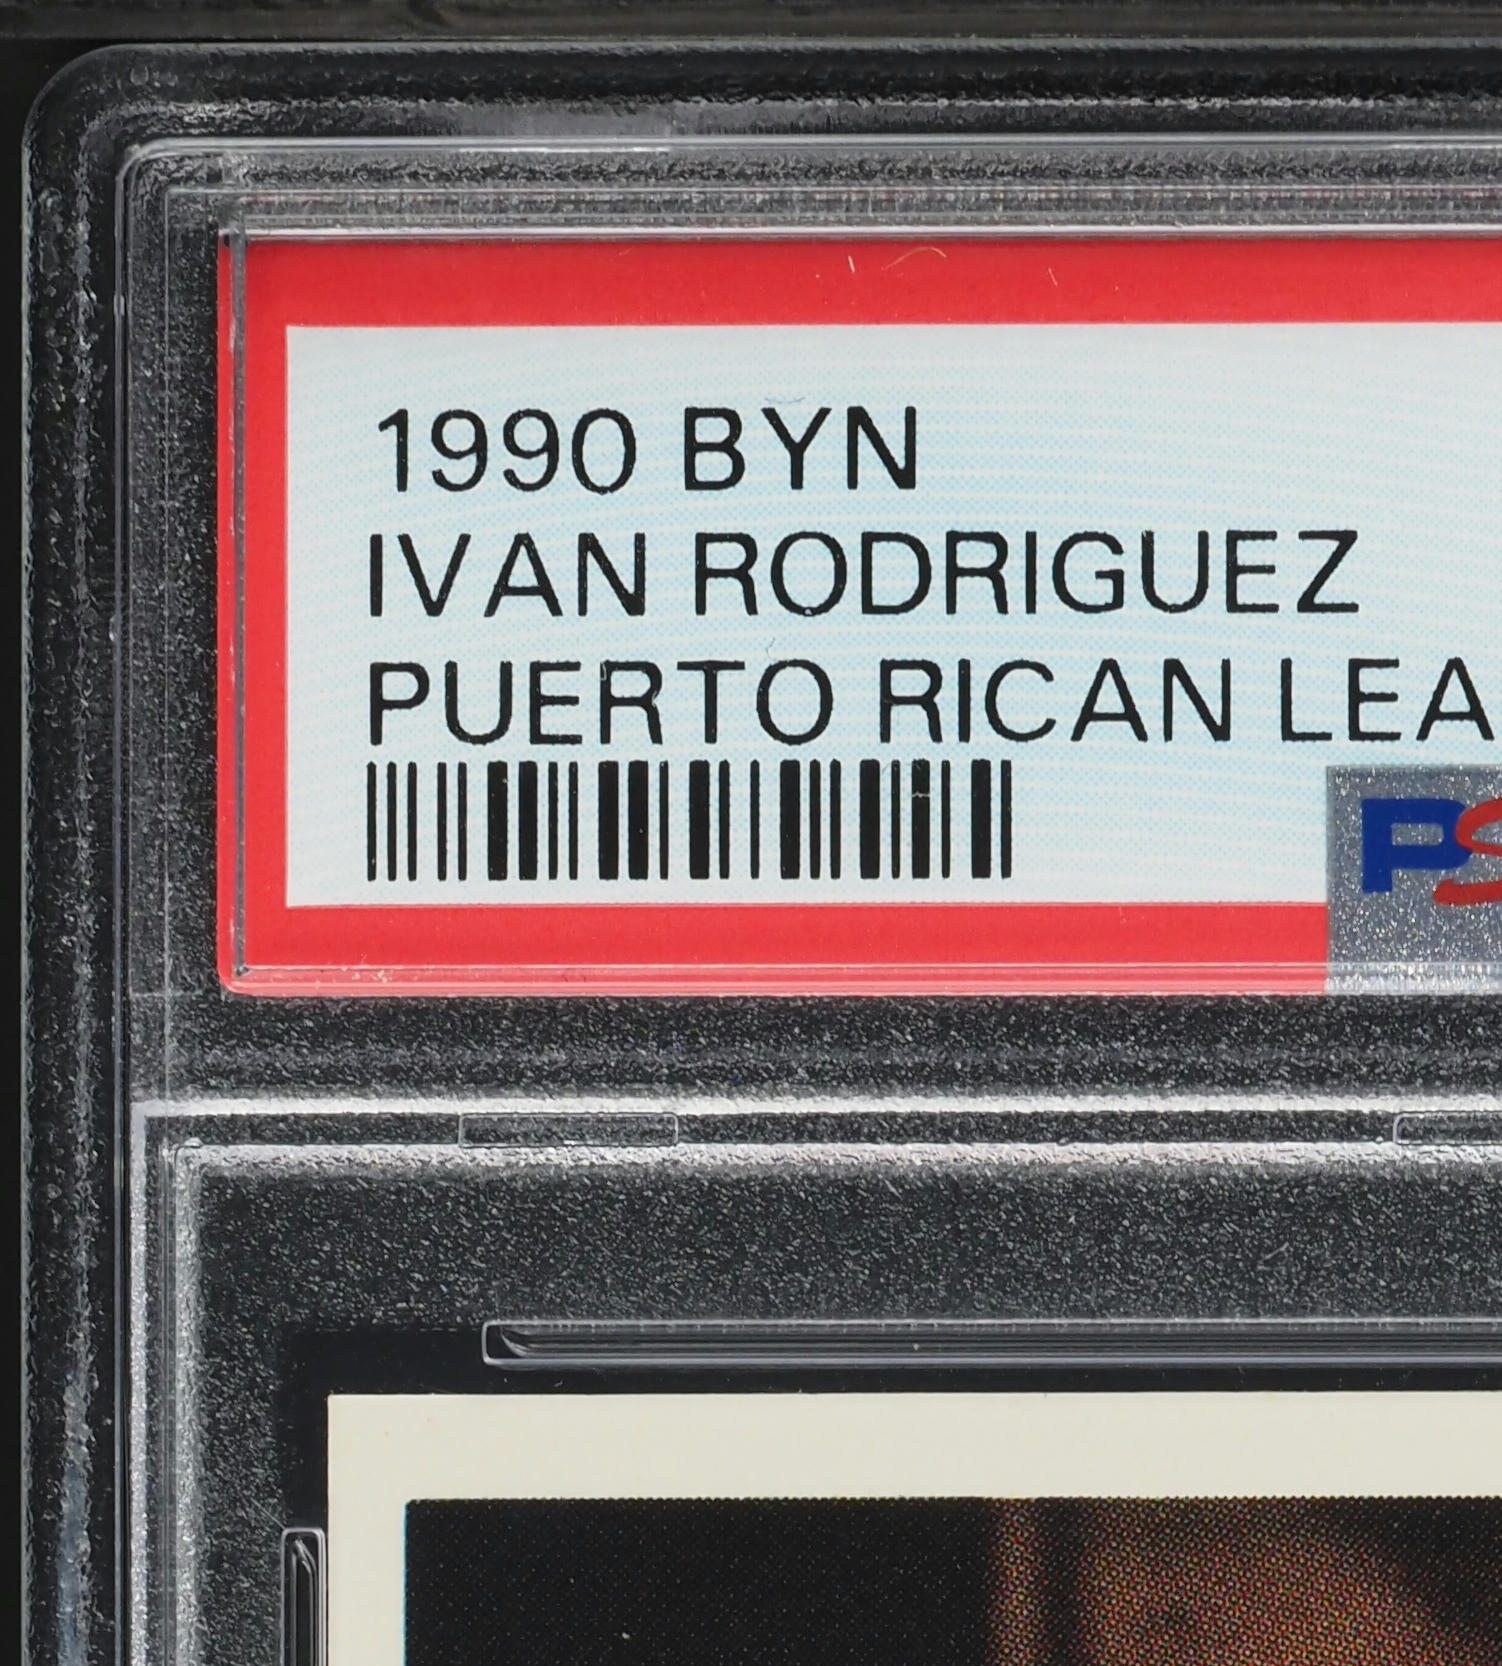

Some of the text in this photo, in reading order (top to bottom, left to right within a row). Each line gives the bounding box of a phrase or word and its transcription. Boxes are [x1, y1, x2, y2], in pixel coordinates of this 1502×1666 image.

[379, 405, 917, 496] 1990 BYN
[369, 529, 1360, 618] IVAN RODRIGUEZ
[369, 658, 834, 747] PUERTO
[879, 656, 1232, 744] RICAN
